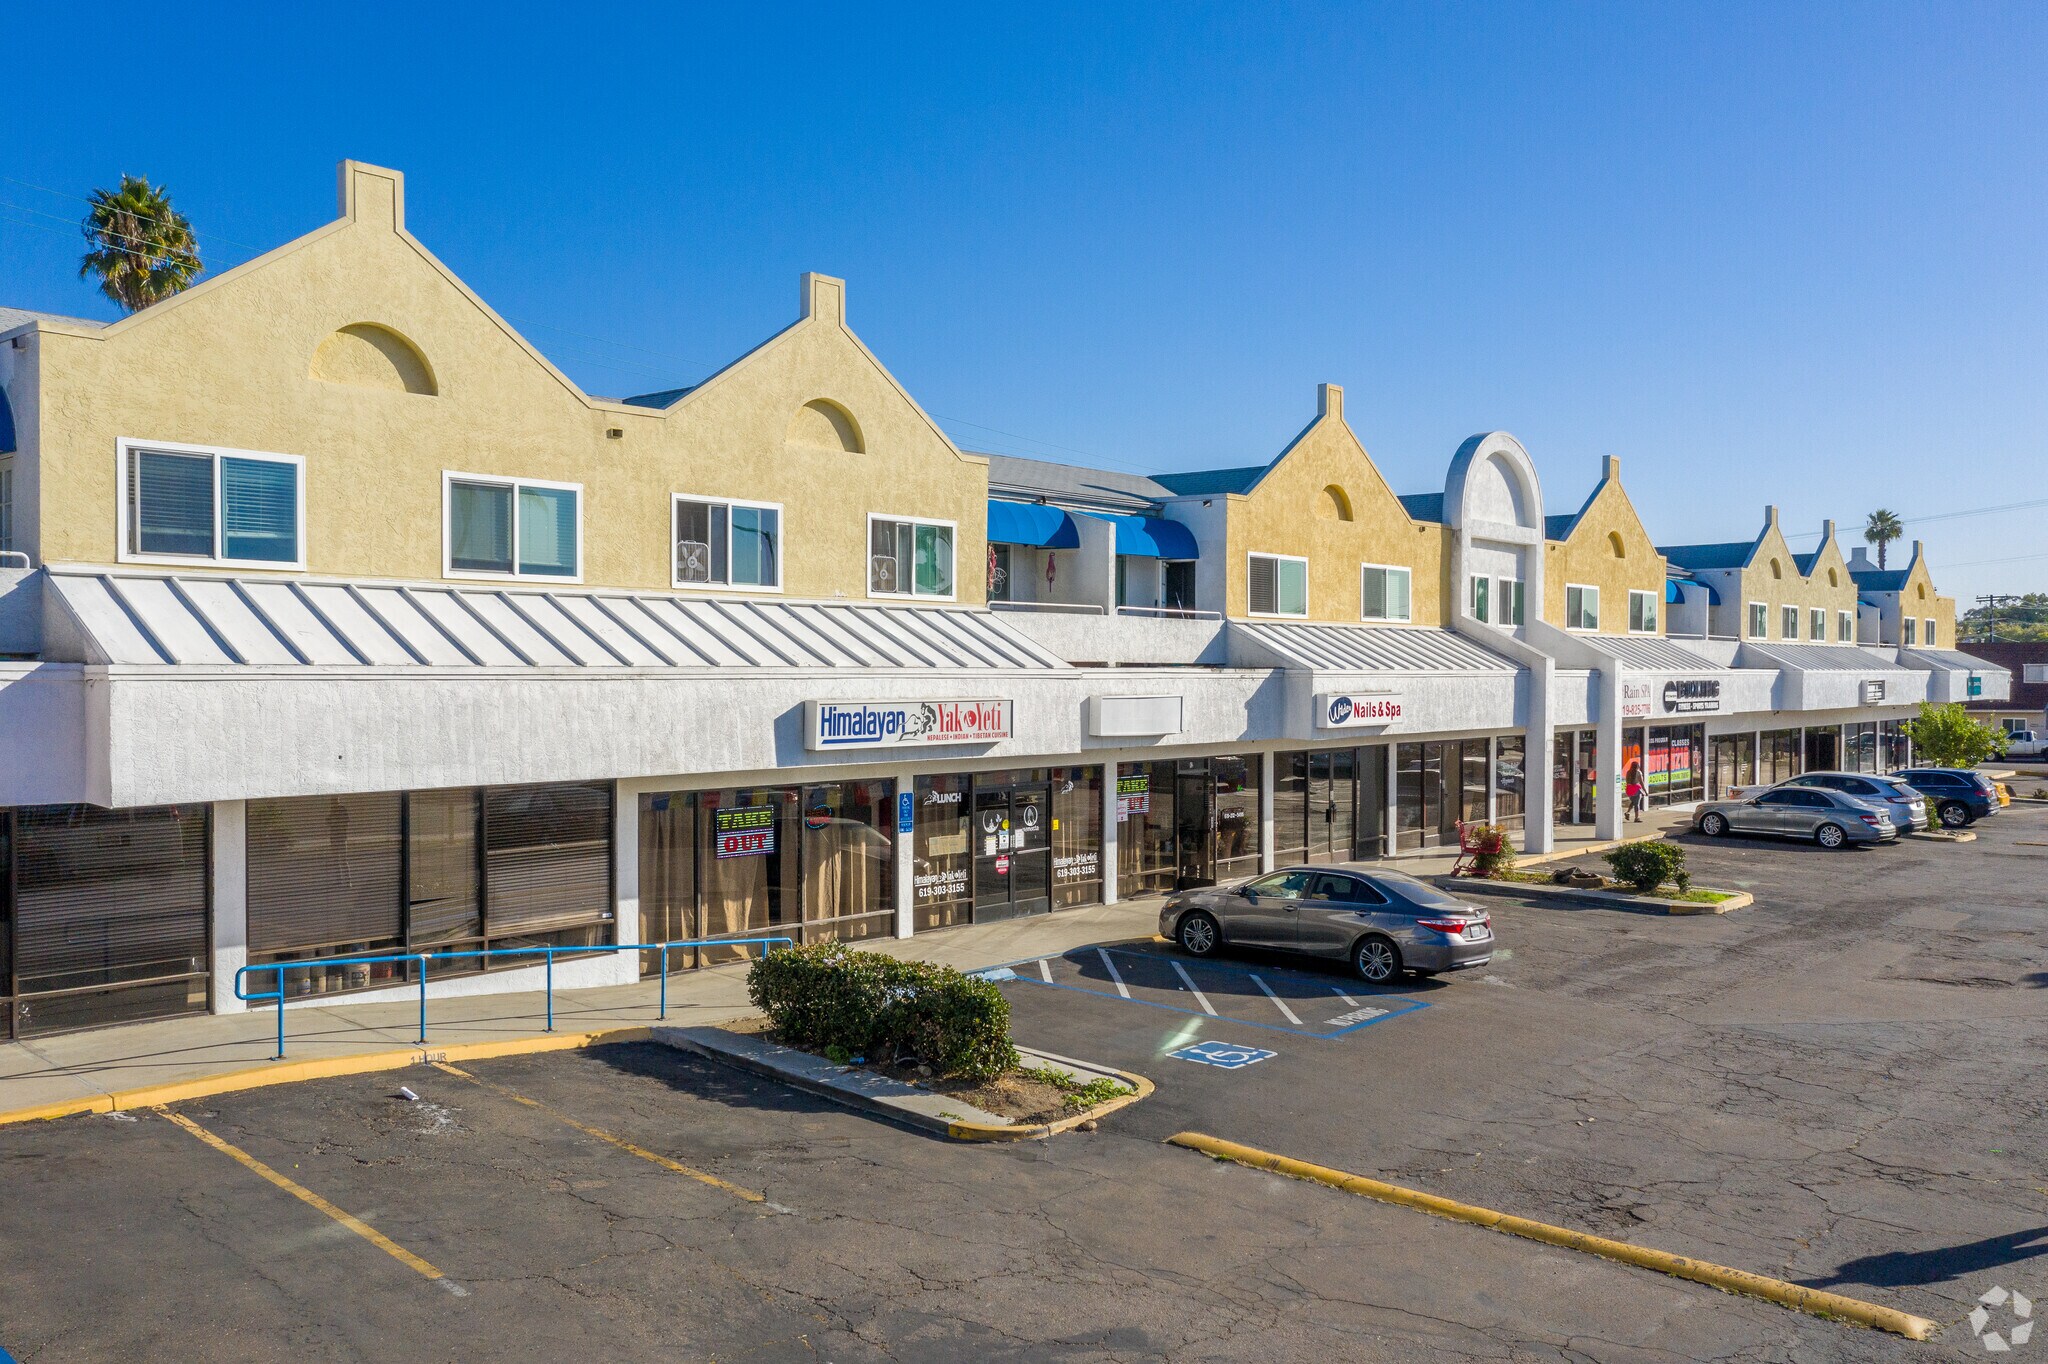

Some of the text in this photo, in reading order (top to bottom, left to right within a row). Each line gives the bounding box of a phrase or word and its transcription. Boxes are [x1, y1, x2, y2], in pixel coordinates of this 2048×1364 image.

[1624, 684, 1640, 699] Rain
[1354, 702, 1376, 719] Nails
[1378, 701, 1384, 717] &
[1385, 701, 1401, 720] Spa
[820, 702, 1002, 744] Himalayan Yak Yeti
[1671, 739, 1690, 747] CLASSES
[937, 793, 961, 804] LUNCH
[719, 811, 771, 829] TAKE
[723, 833, 767, 853] OUT
[1057, 865, 1096, 878] 619-303-3155
[919, 883, 965, 897] 619-303-3155
[419, 1052, 447, 1063] HOUR
